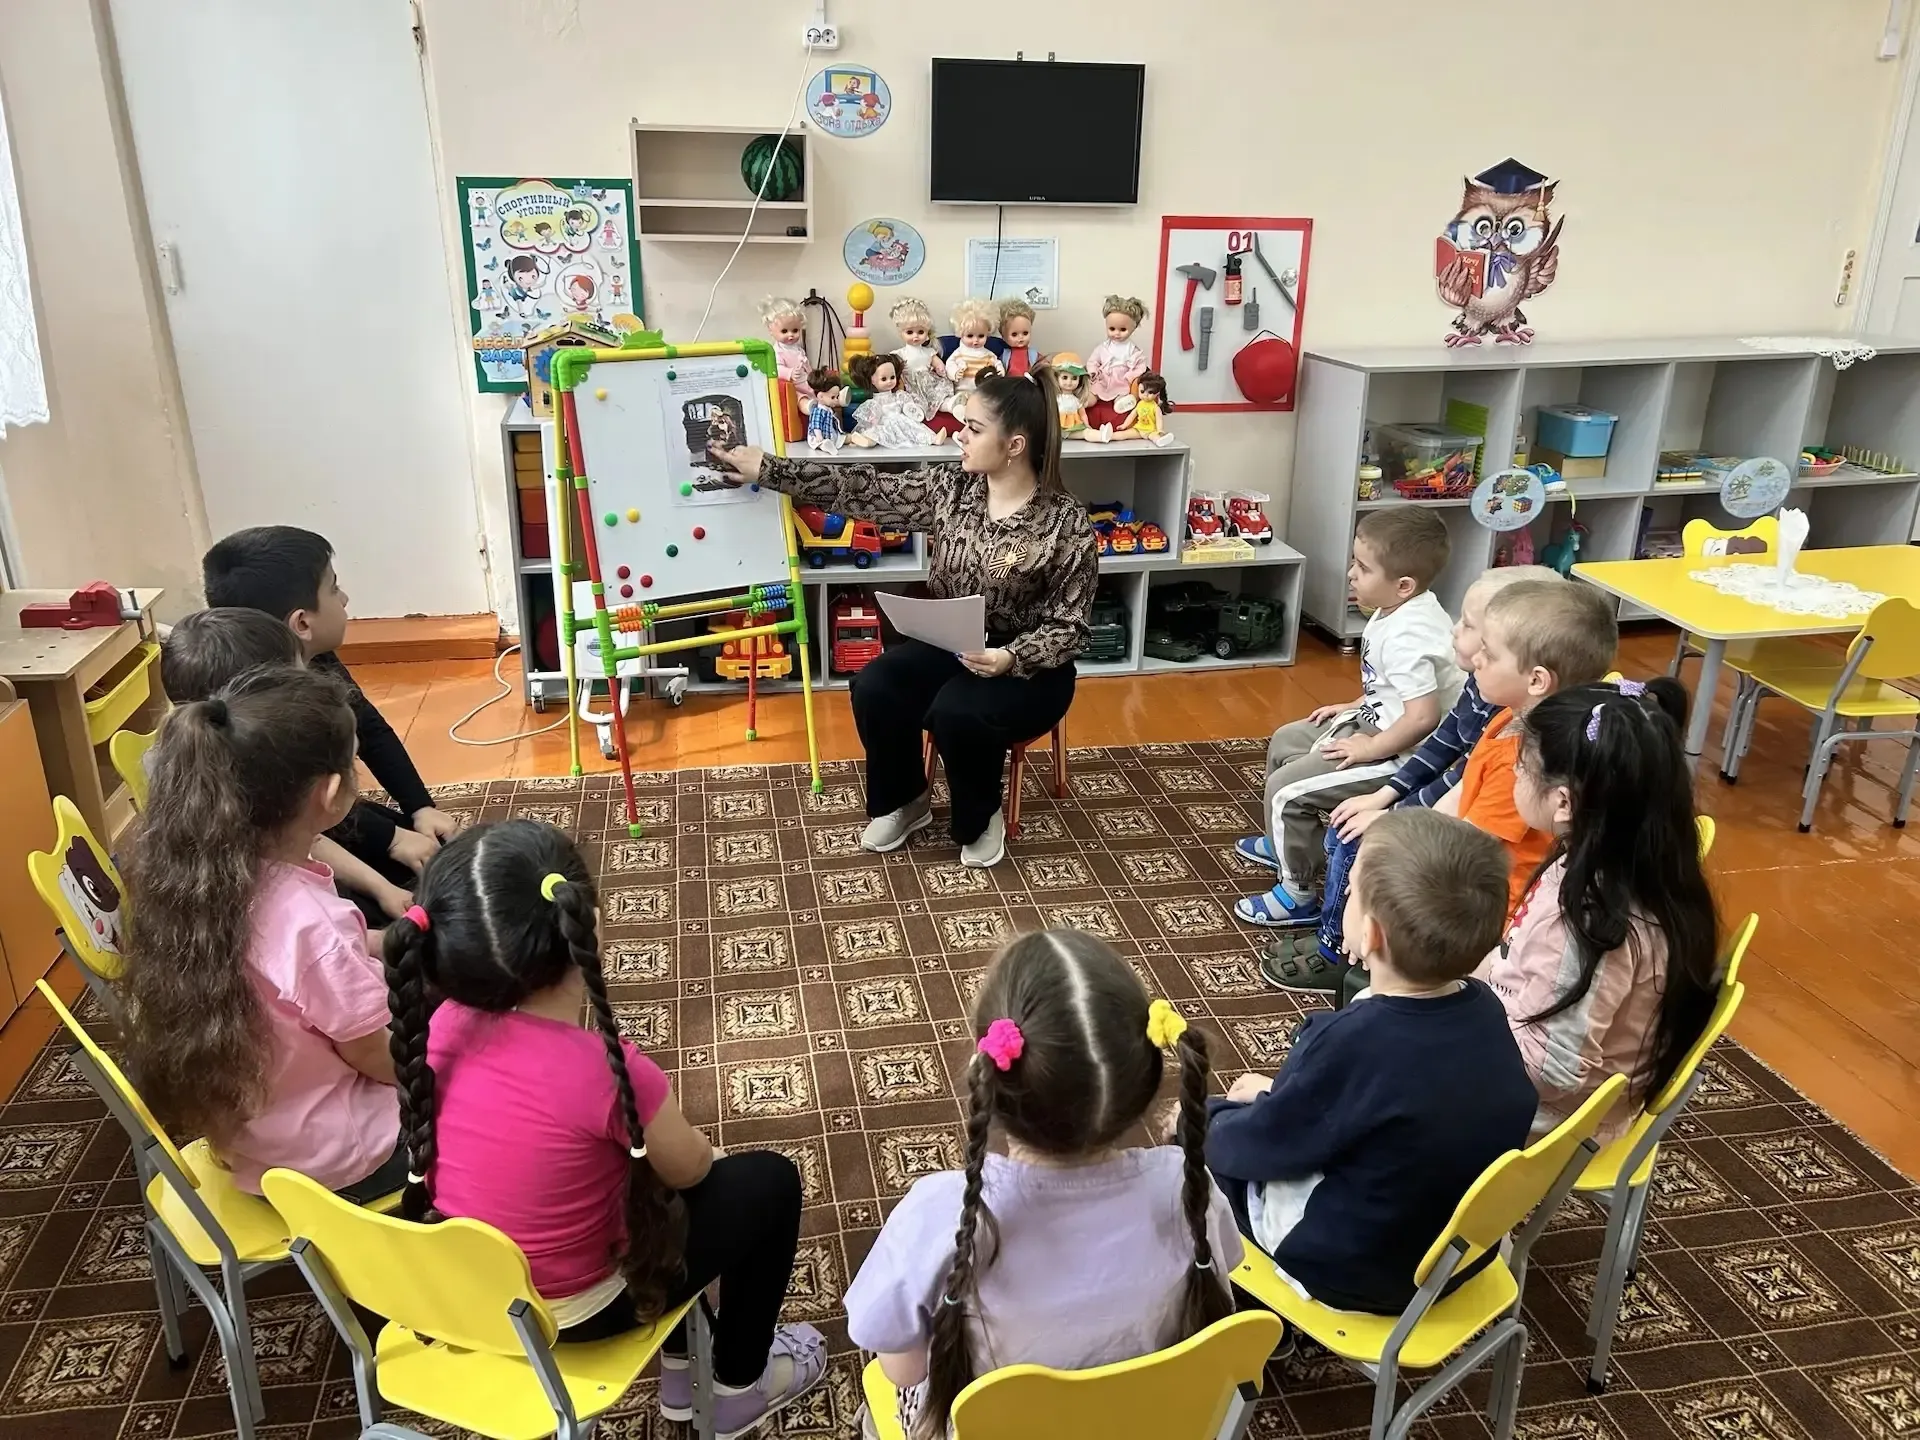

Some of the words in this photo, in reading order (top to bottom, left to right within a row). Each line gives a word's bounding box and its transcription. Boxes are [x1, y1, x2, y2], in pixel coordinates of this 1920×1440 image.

[498, 194, 571, 215] СПОРТИВНЫЙ
[516, 205, 554, 218] УГОЛОК
[1228, 231, 1253, 252] 01
